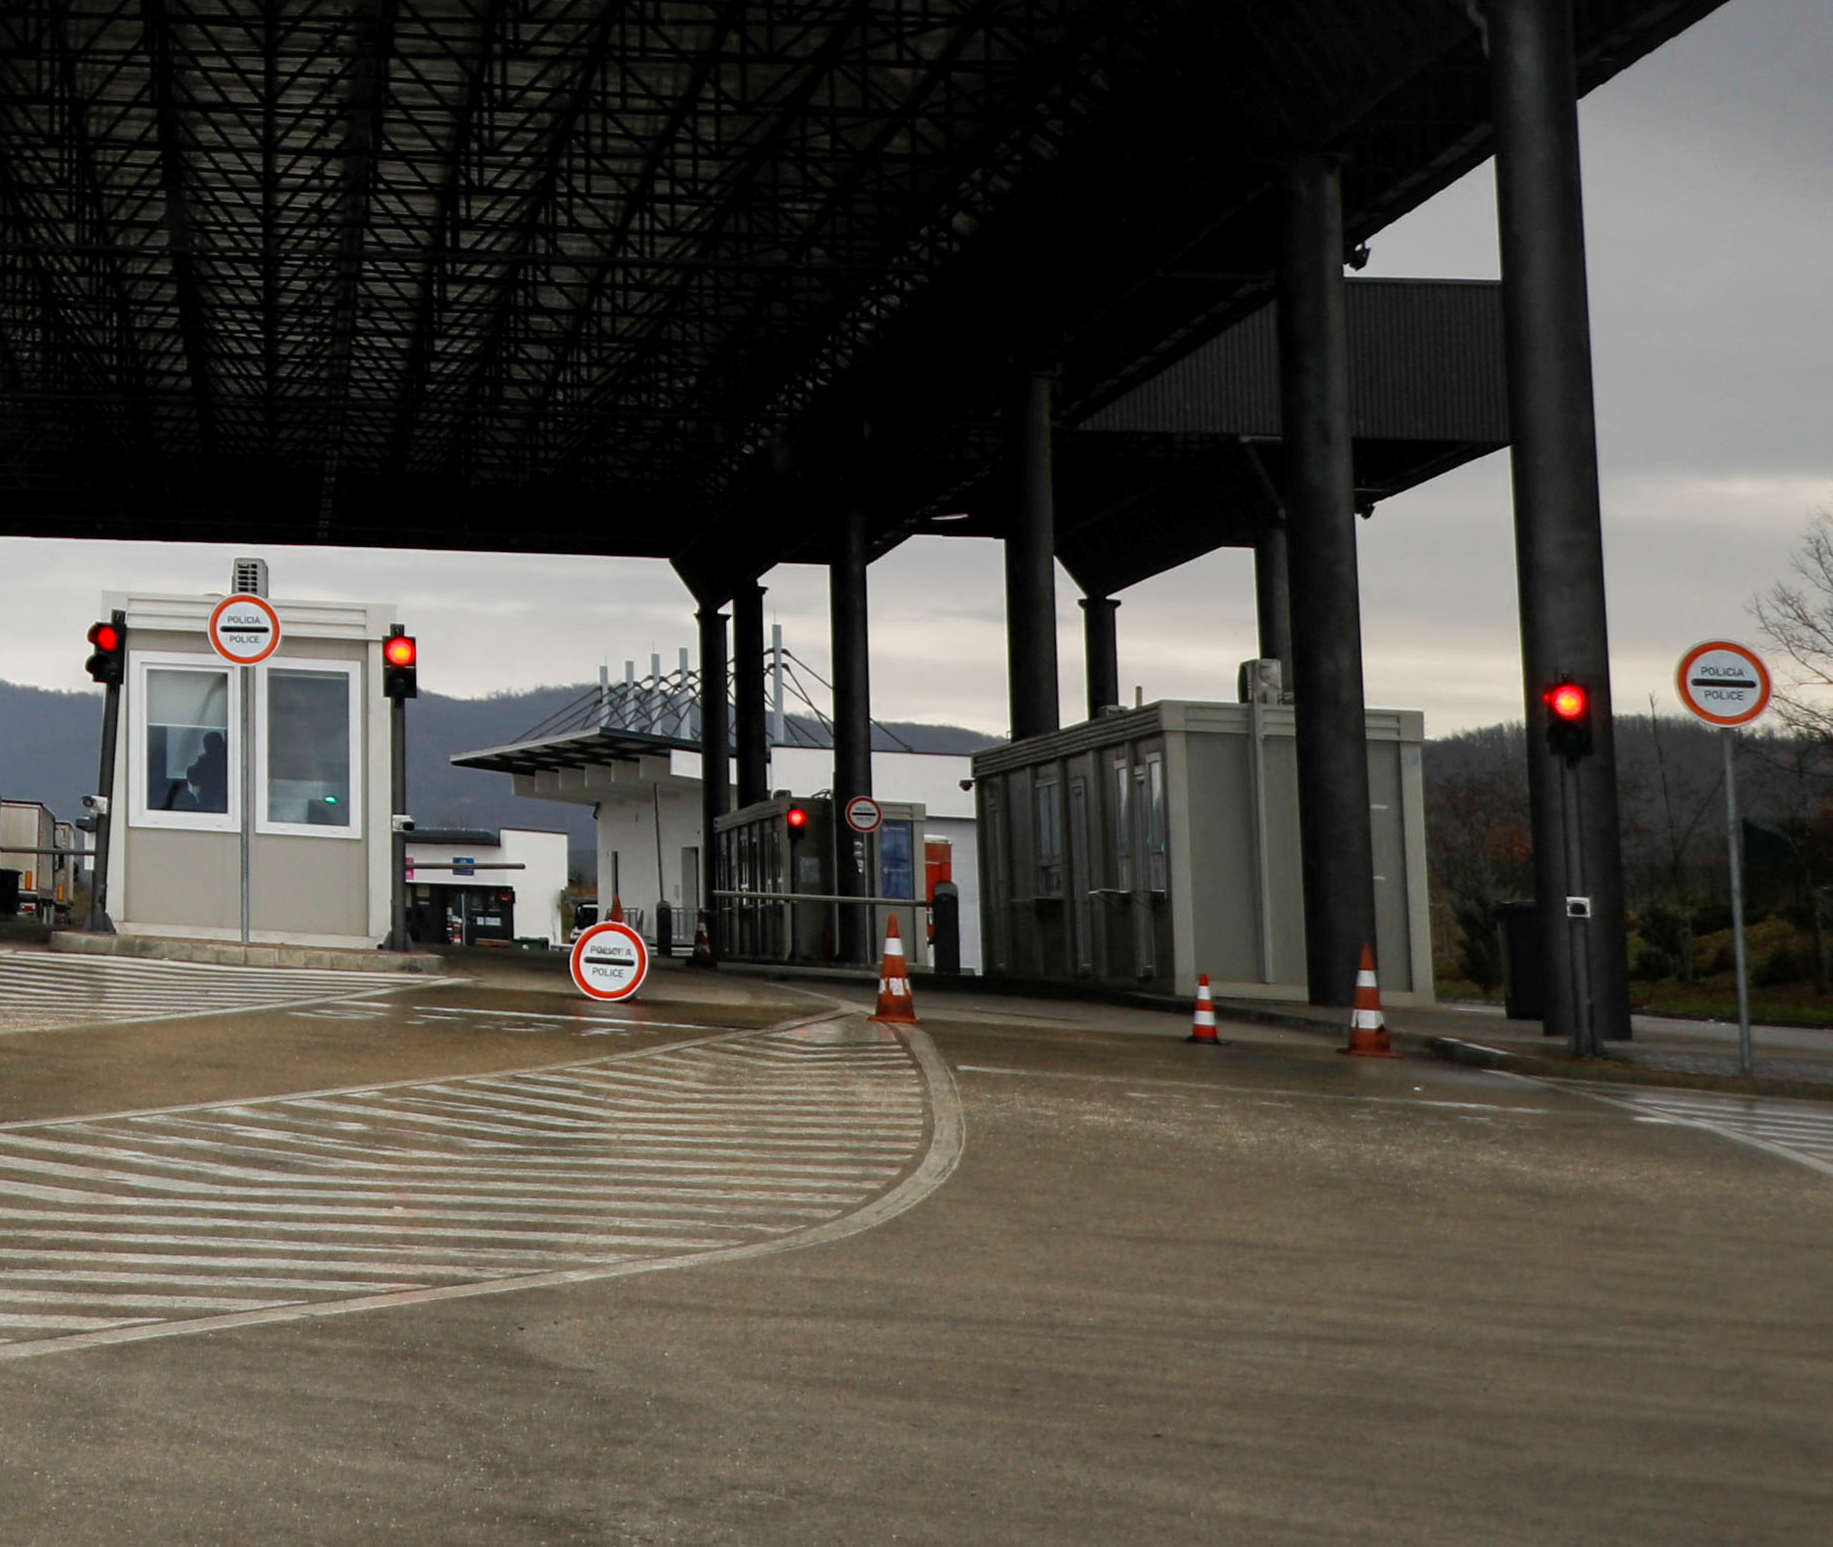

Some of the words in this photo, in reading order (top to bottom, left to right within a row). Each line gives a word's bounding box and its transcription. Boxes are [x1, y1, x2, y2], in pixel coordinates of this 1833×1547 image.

[227, 615, 261, 624] POLICIA
[229, 635, 260, 644] POLICE
[1700, 666, 1745, 677] POLICIA
[1703, 689, 1744, 701] POLICE
[591, 966, 624, 979] POLICE
